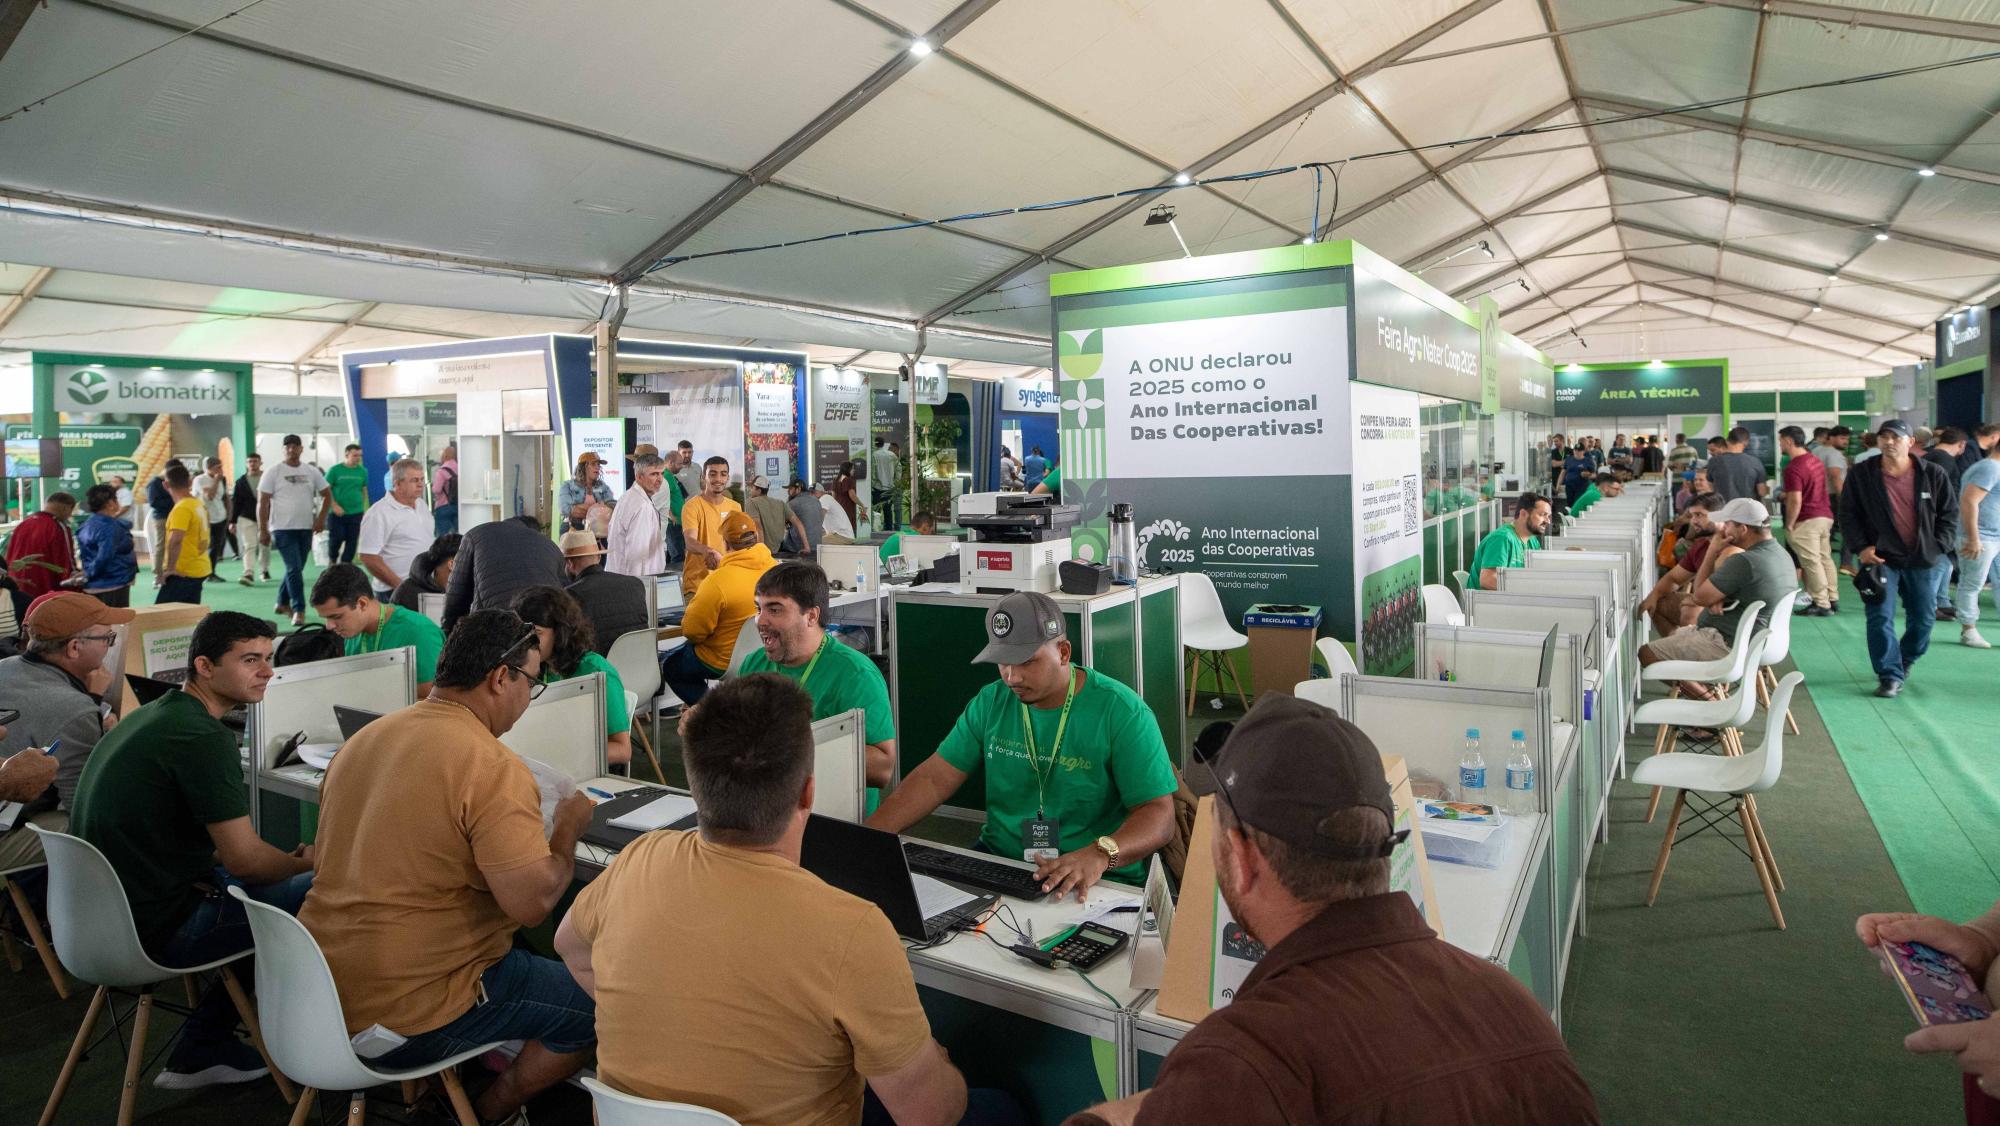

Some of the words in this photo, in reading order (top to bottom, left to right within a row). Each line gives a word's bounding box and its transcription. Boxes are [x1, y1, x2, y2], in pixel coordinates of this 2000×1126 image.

[1377, 316, 1402, 350] Feira
[1423, 335, 1444, 366] Nater
[1444, 343, 1461, 376] Coop
[1461, 350, 1477, 377] 2025
[1128, 360, 1143, 375] A
[1149, 356, 1194, 374] ONU
[1200, 352, 1292, 370] declarou
[118, 381, 232, 401] biomatrix
[1129, 379, 1185, 397] 2025
[1191, 379, 1247, 393] como
[1253, 378, 1266, 390] o
[1555, 387, 1583, 396] nater
[1600, 388, 1637, 400] ÁREA
[1639, 386, 1700, 399] TÉCNICA
[1130, 403, 1169, 419] Ano
[1175, 394, 1318, 417] Internacional
[1130, 424, 1168, 441] Das
[1173, 418, 1324, 442] Cooperativas!
[1360, 428, 1384, 440] CONCORRA
[1201, 527, 1226, 540] Ano
[1231, 527, 1319, 541] Internacional
[1161, 549, 1195, 563] 2025
[1201, 541, 1224, 556] das
[1227, 543, 1315, 558] Cooperativas
[1201, 569, 1247, 579] Cooperativas
[1247, 571, 1288, 580] constroem
[1215, 581, 1242, 589] mundo
[1243, 581, 1270, 590] melhor
[1261, 617, 1298, 625] RECICLÁVEL
[168, 642, 190, 651] CUPO
[995, 745, 1013, 757] força
[1014, 751, 1031, 760] que
